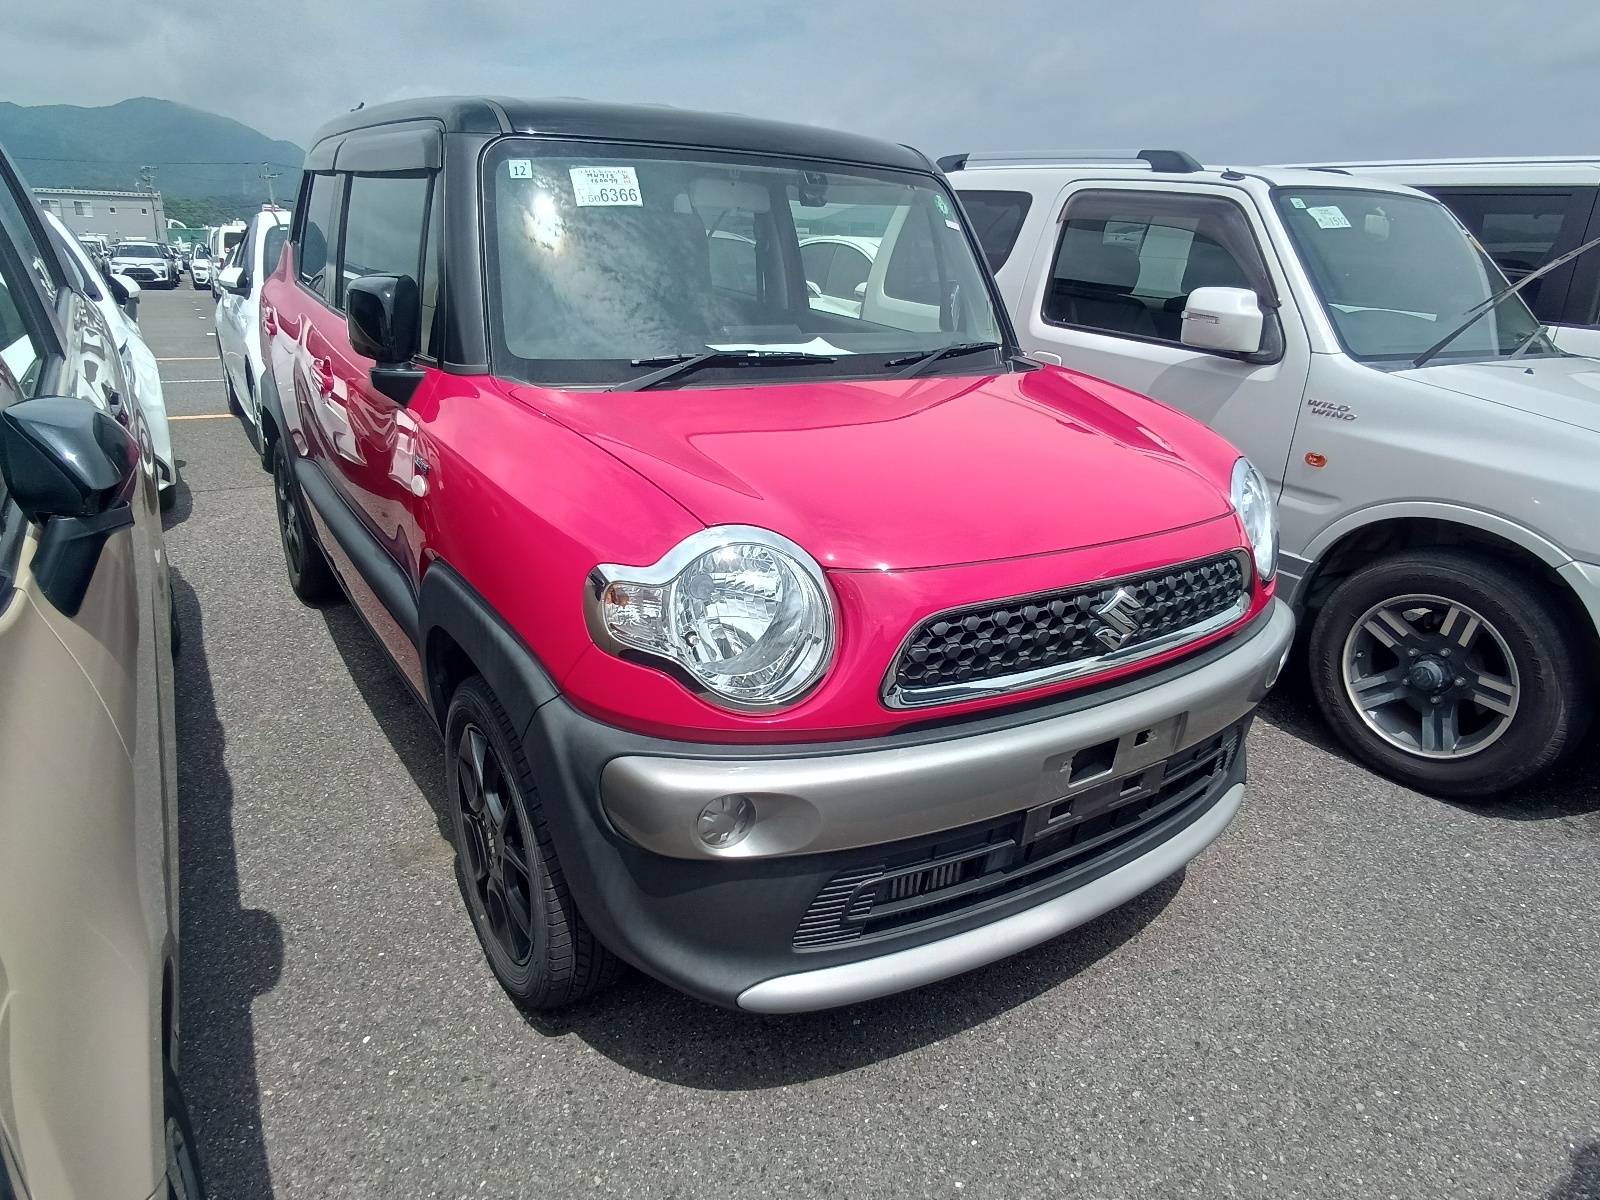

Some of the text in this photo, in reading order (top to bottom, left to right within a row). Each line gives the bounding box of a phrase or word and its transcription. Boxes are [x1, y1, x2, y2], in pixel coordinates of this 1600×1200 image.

[513, 165, 527, 176] 12
[1307, 399, 1351, 412] WILD
[1312, 407, 1357, 421] WIND
